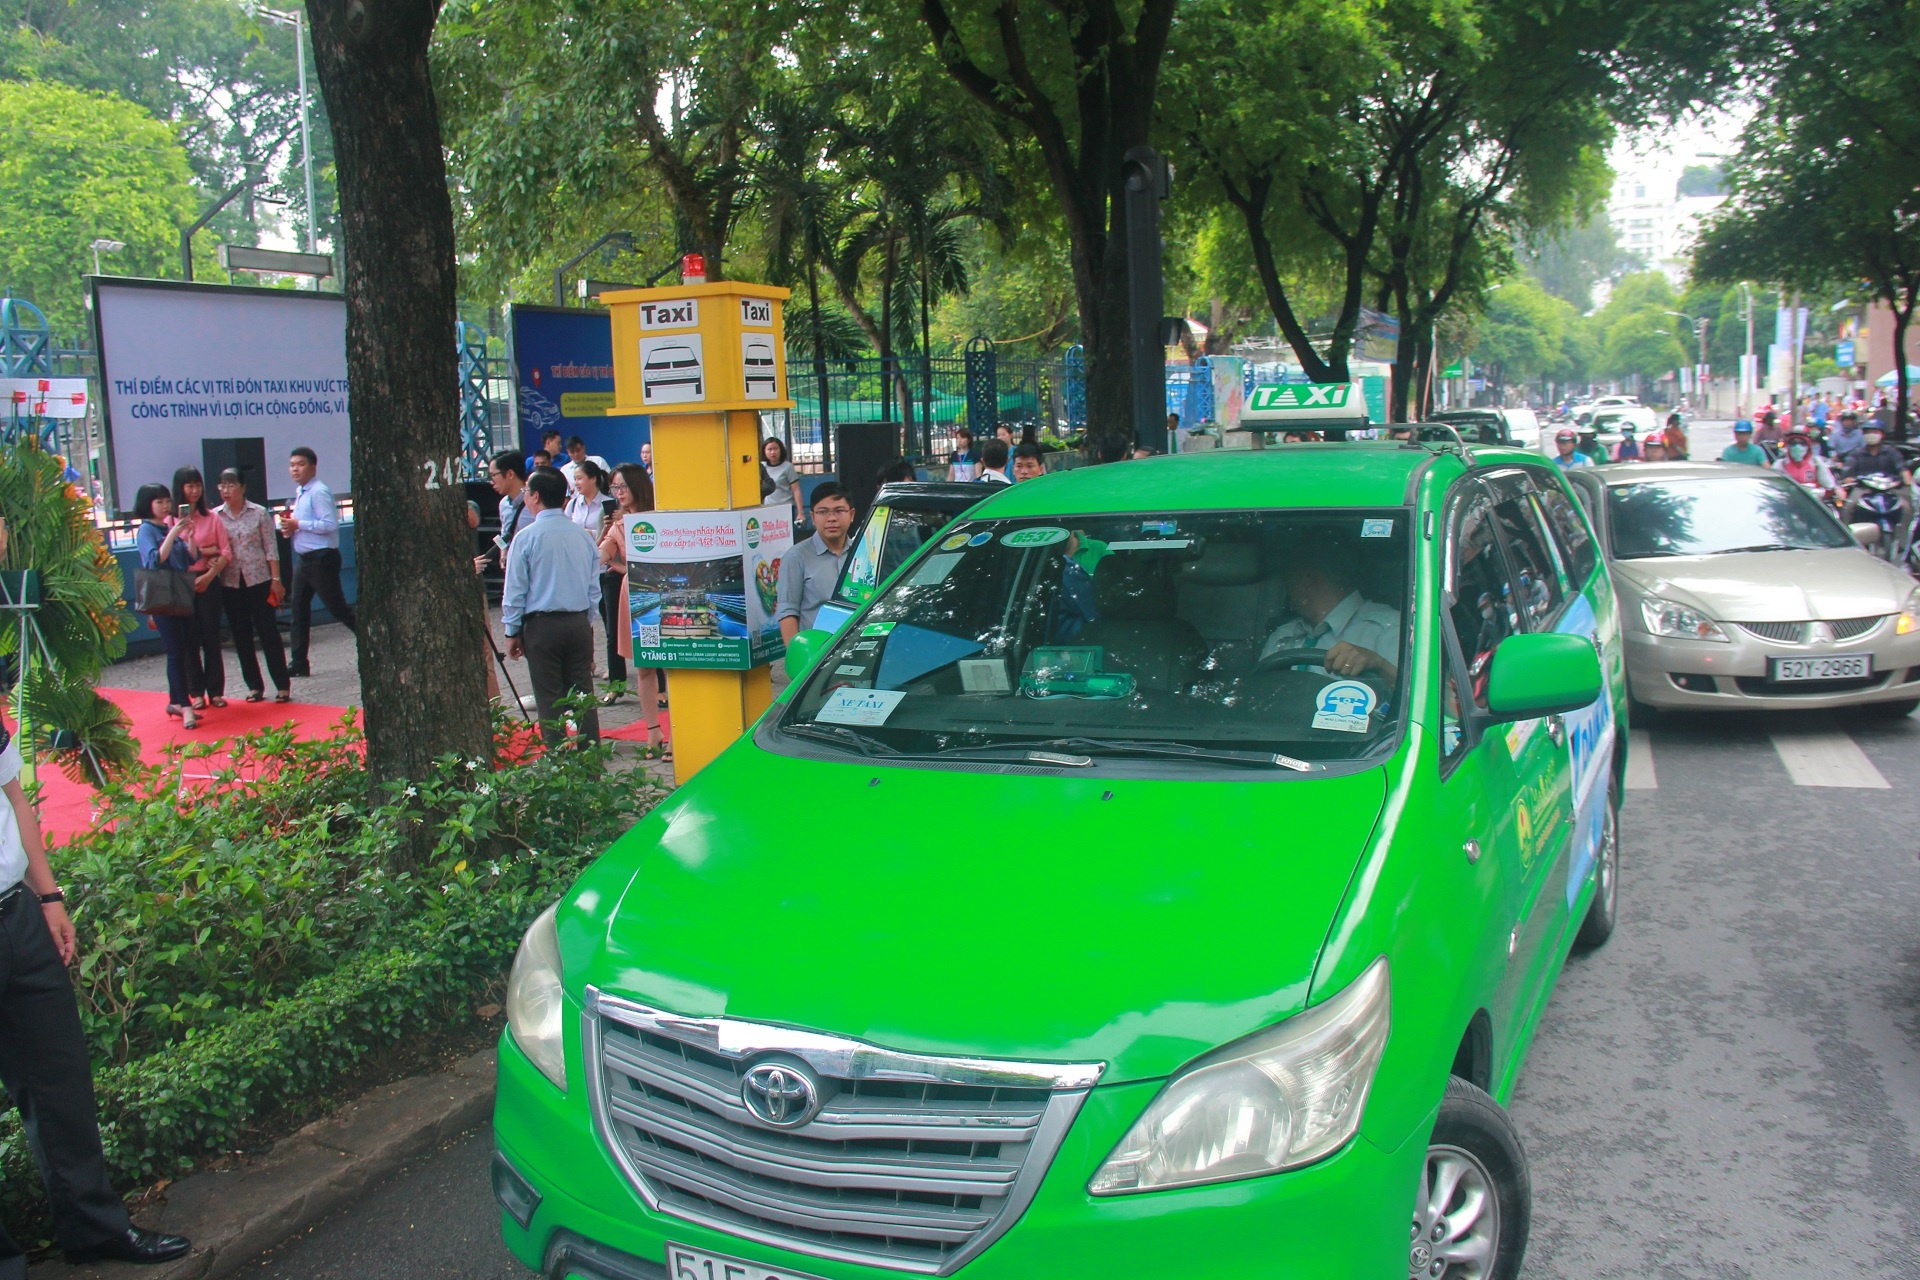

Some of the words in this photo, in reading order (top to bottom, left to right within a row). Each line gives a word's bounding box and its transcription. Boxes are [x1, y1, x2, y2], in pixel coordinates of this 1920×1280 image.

[641, 302, 693, 325] Taxi
[741, 300, 770, 321] Taxi
[115, 377, 138, 395] THÍ
[139, 375, 173, 395] ĐIỂM
[176, 377, 201, 395] CÁC
[201, 380, 215, 398] VỊ
[216, 377, 234, 394] TRÍ
[236, 377, 262, 394] ĐÓN
[263, 380, 288, 394] TAXI
[289, 380, 312, 393] KHU
[313, 378, 336, 396] VỰC
[131, 401, 168, 419] CÔNG
[170, 401, 208, 418] TRÌNH
[209, 400, 222, 417] VÌ
[224, 402, 243, 420] LỢI
[244, 400, 264, 416] ÍCH
[266, 400, 297, 419] CỘNG
[334, 397, 345, 413] VÌ
[424, 456, 464, 490] 242
[696, 525, 715, 537] nhập
[1010, 531, 1060, 543] 6537
[714, 536, 737, 547] Nam
[647, 649, 667, 661] TẦNG
[668, 652, 677, 661] B1
[1782, 659, 1862, 678] 52Y-2966
[1280, 757, 1304, 768] TOYOTA
